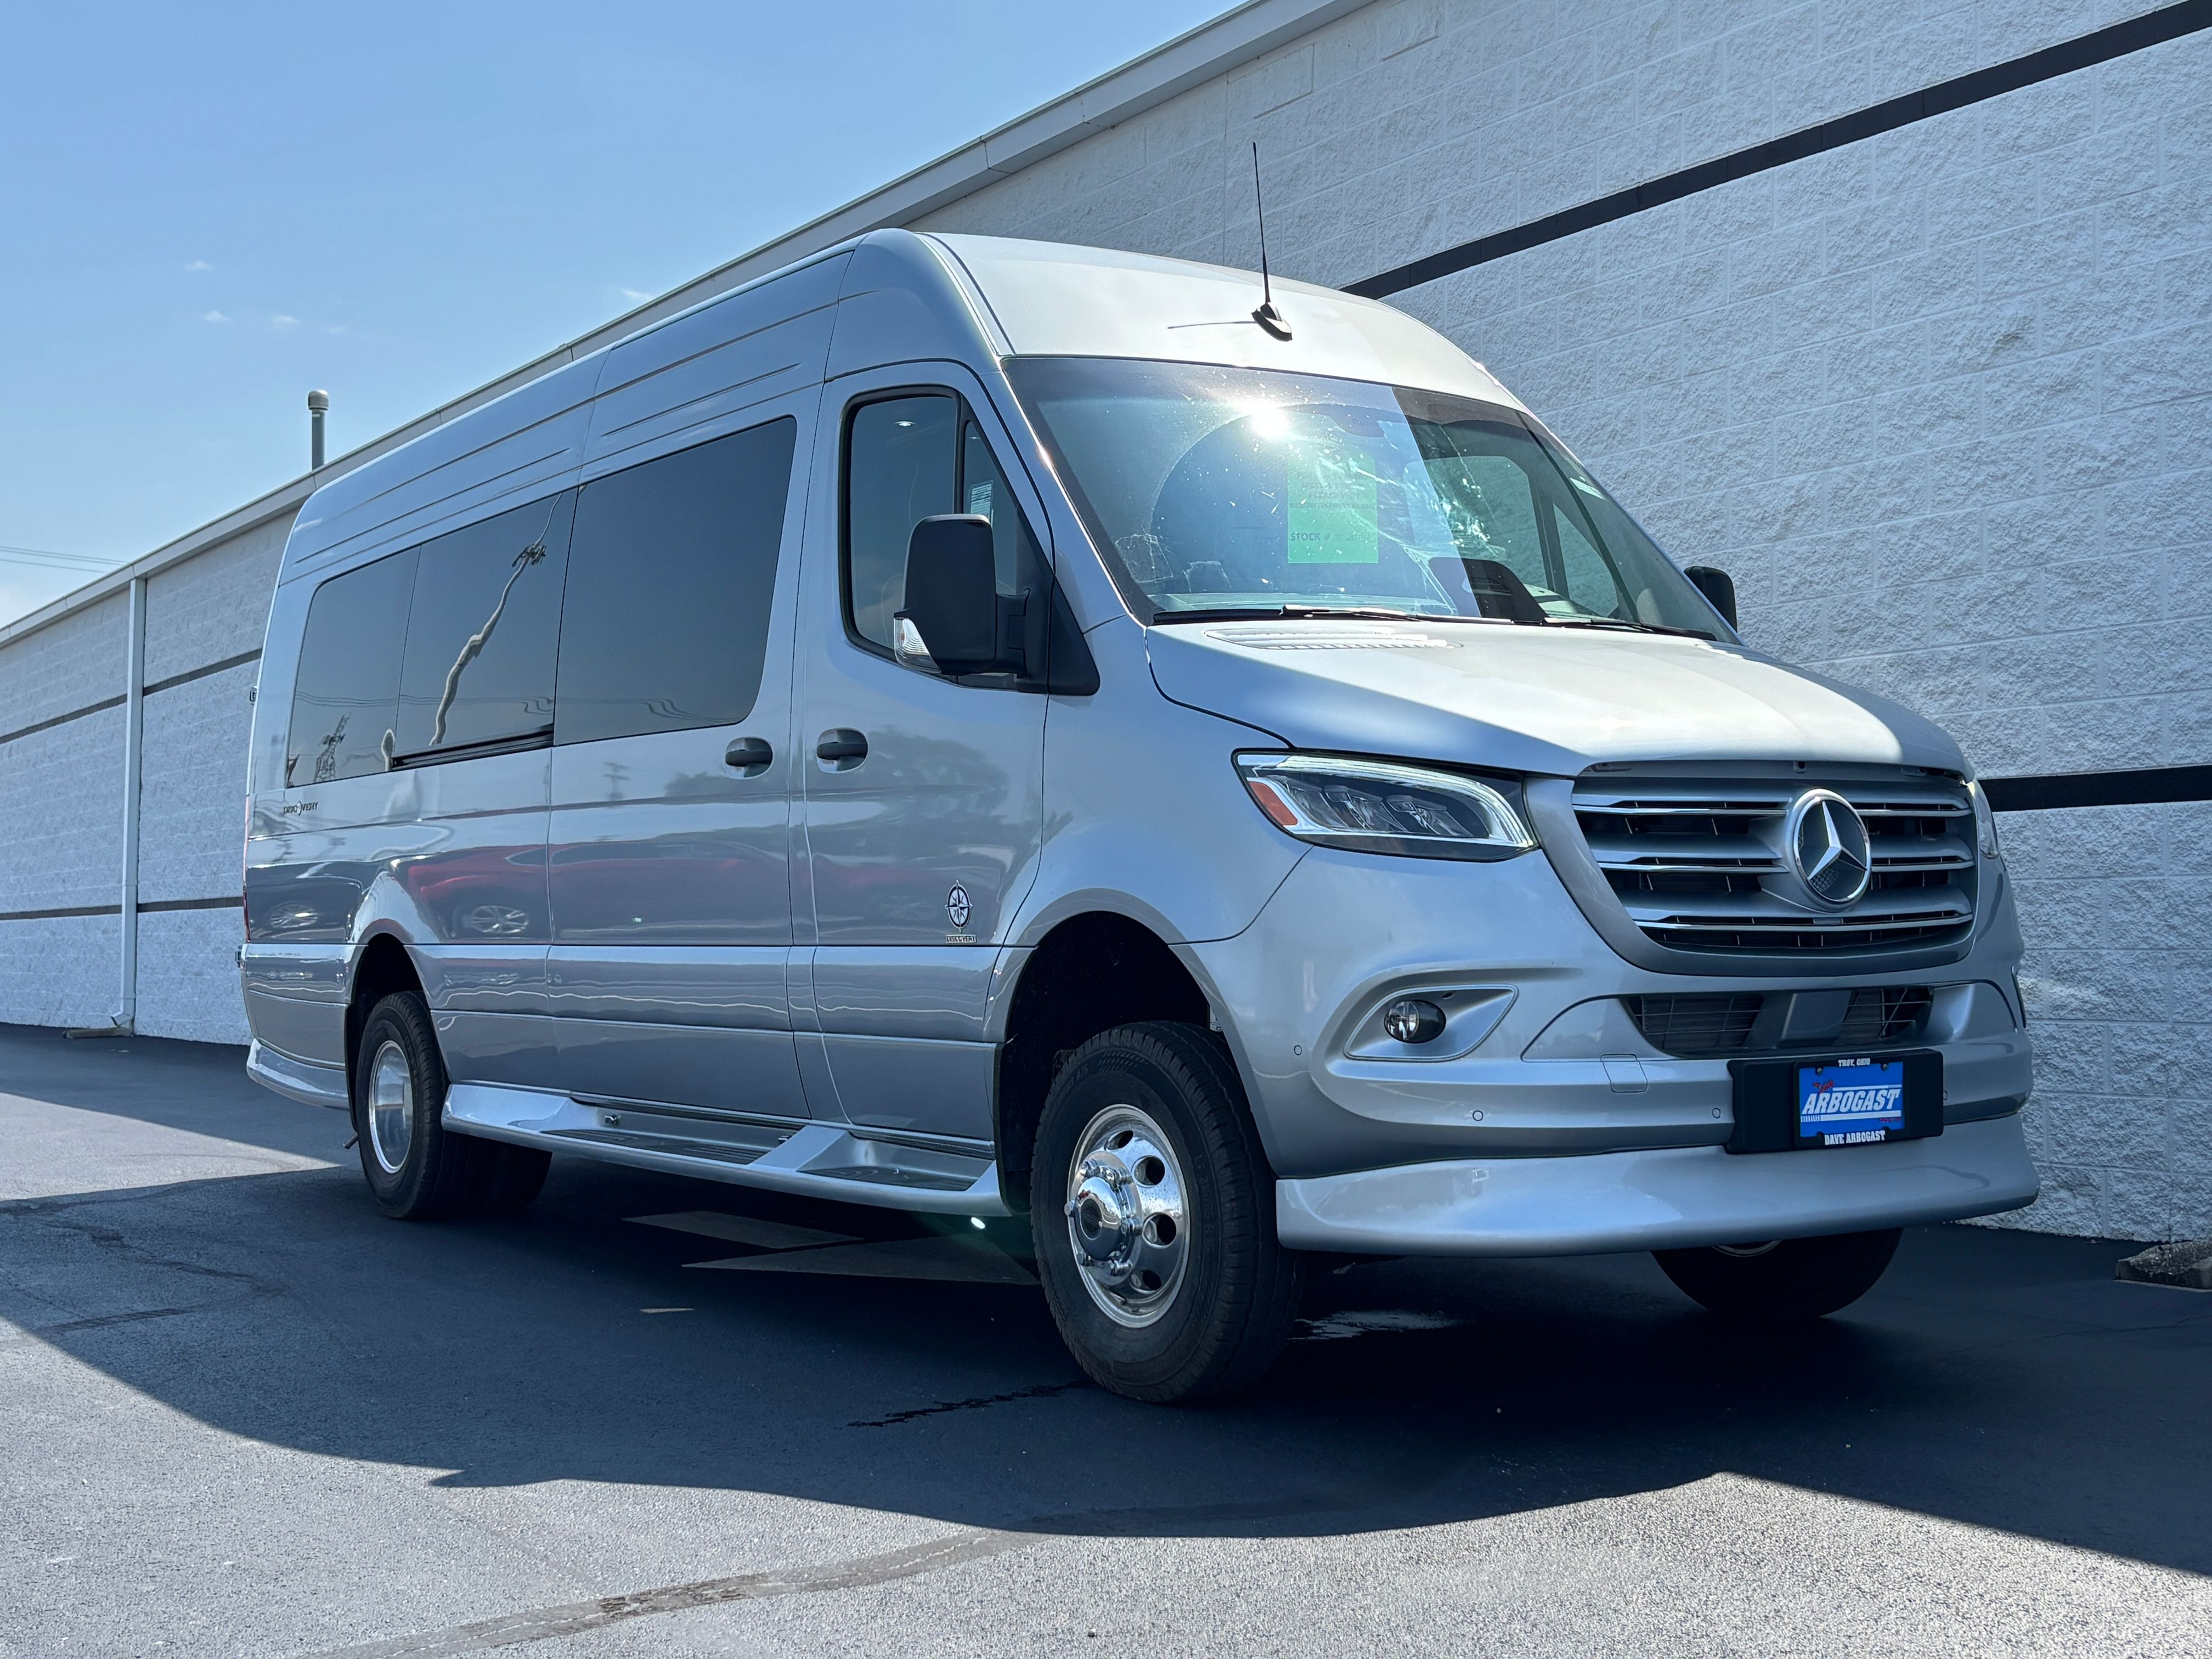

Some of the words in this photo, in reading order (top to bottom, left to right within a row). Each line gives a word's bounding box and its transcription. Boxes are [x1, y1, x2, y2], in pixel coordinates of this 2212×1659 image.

[1290, 532, 1321, 541] STOCK
[1802, 1088, 1901, 1115] ARBOGAST
[1824, 1133, 1845, 1146] DAVE
[1846, 1130, 1886, 1144] ARBOGAST
